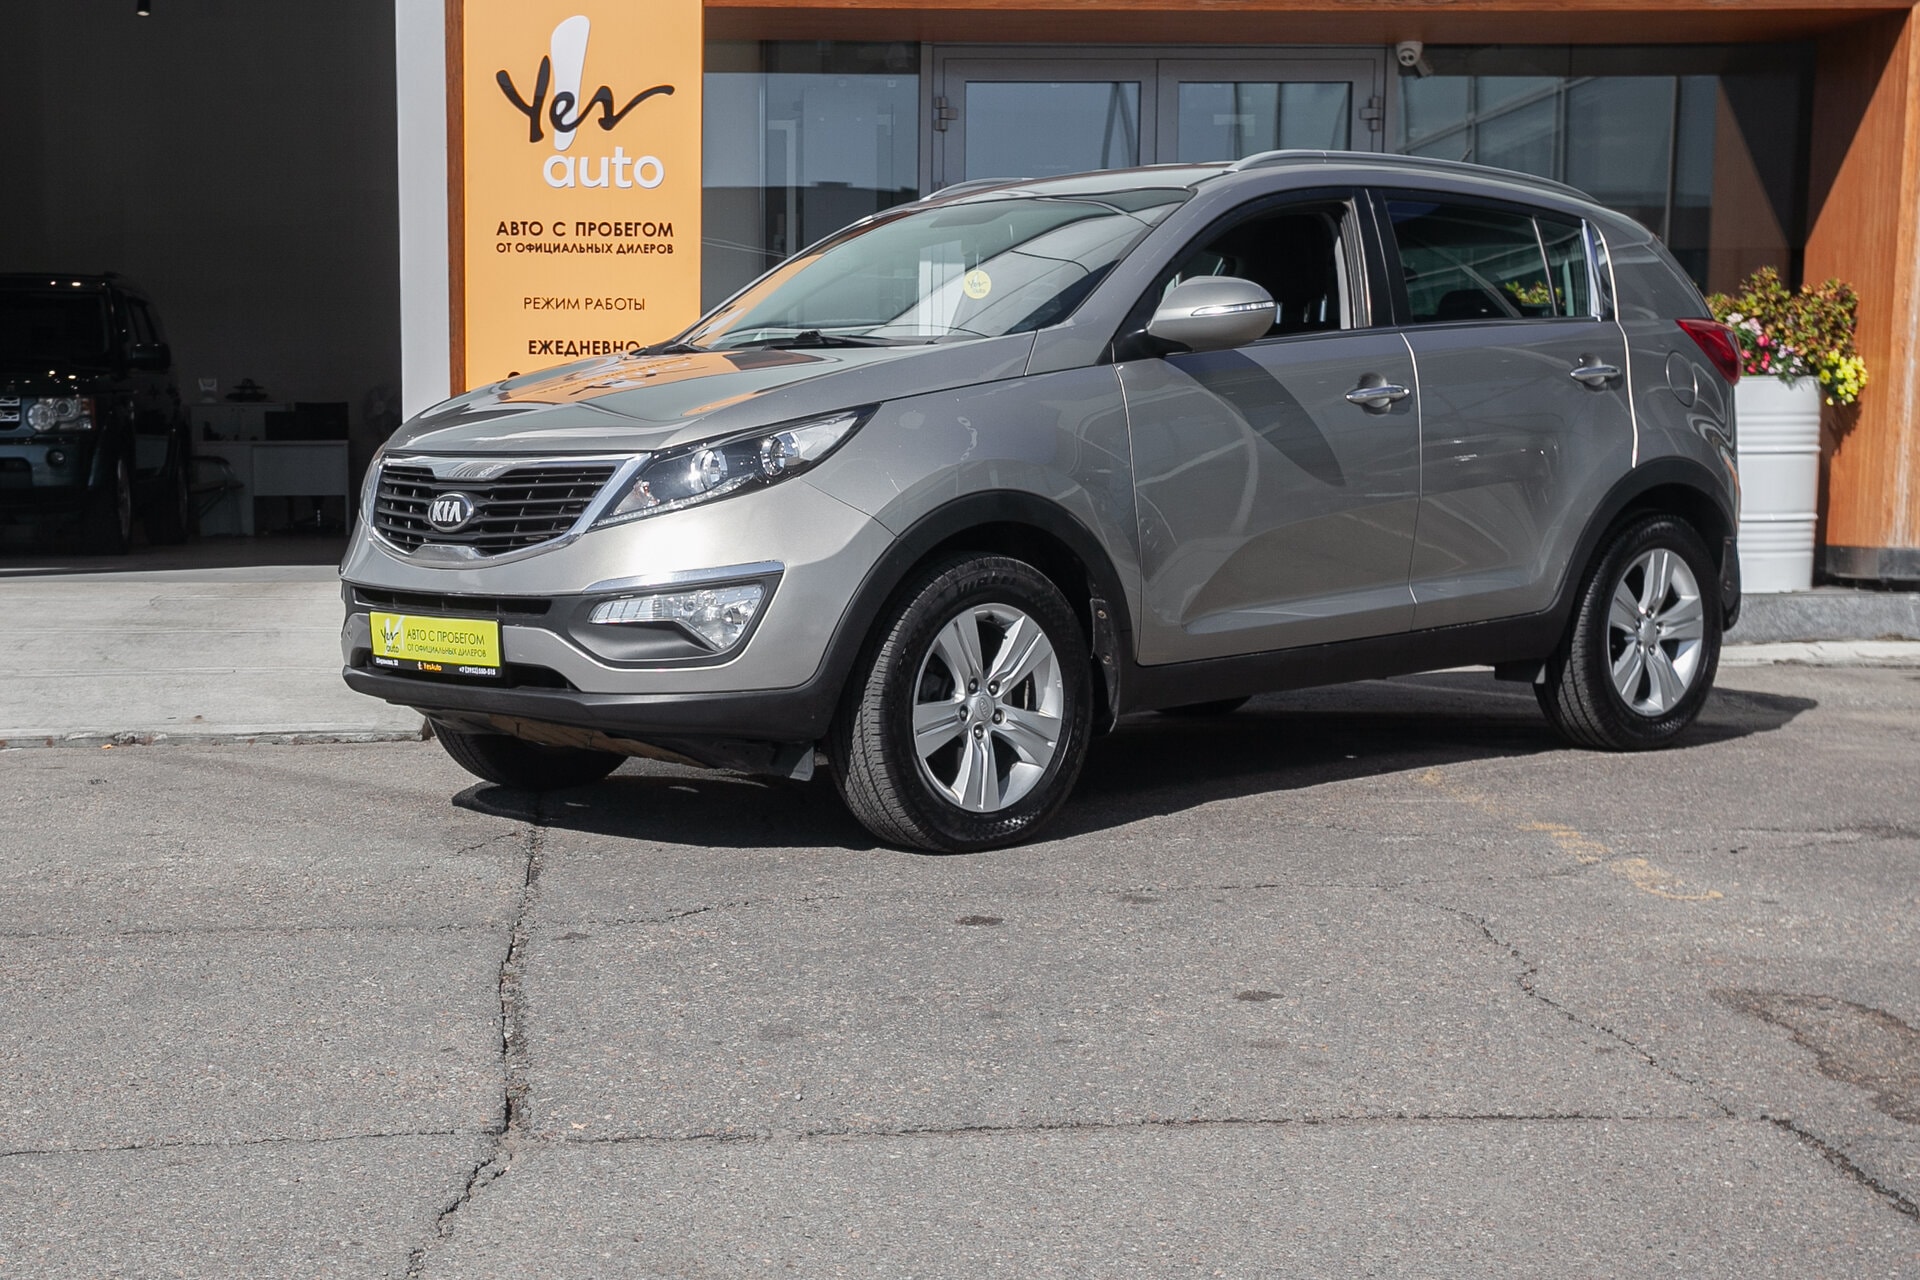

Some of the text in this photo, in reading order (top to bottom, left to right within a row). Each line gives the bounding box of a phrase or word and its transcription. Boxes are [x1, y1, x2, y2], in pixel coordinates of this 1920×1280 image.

[543, 146, 665, 189] auto
[496, 221, 674, 238] АВТО С ПРОБЕГОМ
[496, 242, 674, 255] ОТ ОФИЦИАЛЬНЫХ ДИЛЕРОВ
[523, 297, 645, 311] РЕЖИМ РАБОТЫ
[432, 501, 461, 522] KIA
[407, 629, 485, 646] АВТО С ПРОБЕГОМ
[407, 643, 487, 658] ОТ ОФИЦИАЛЬНЫХ ДИЛЕРОВ
